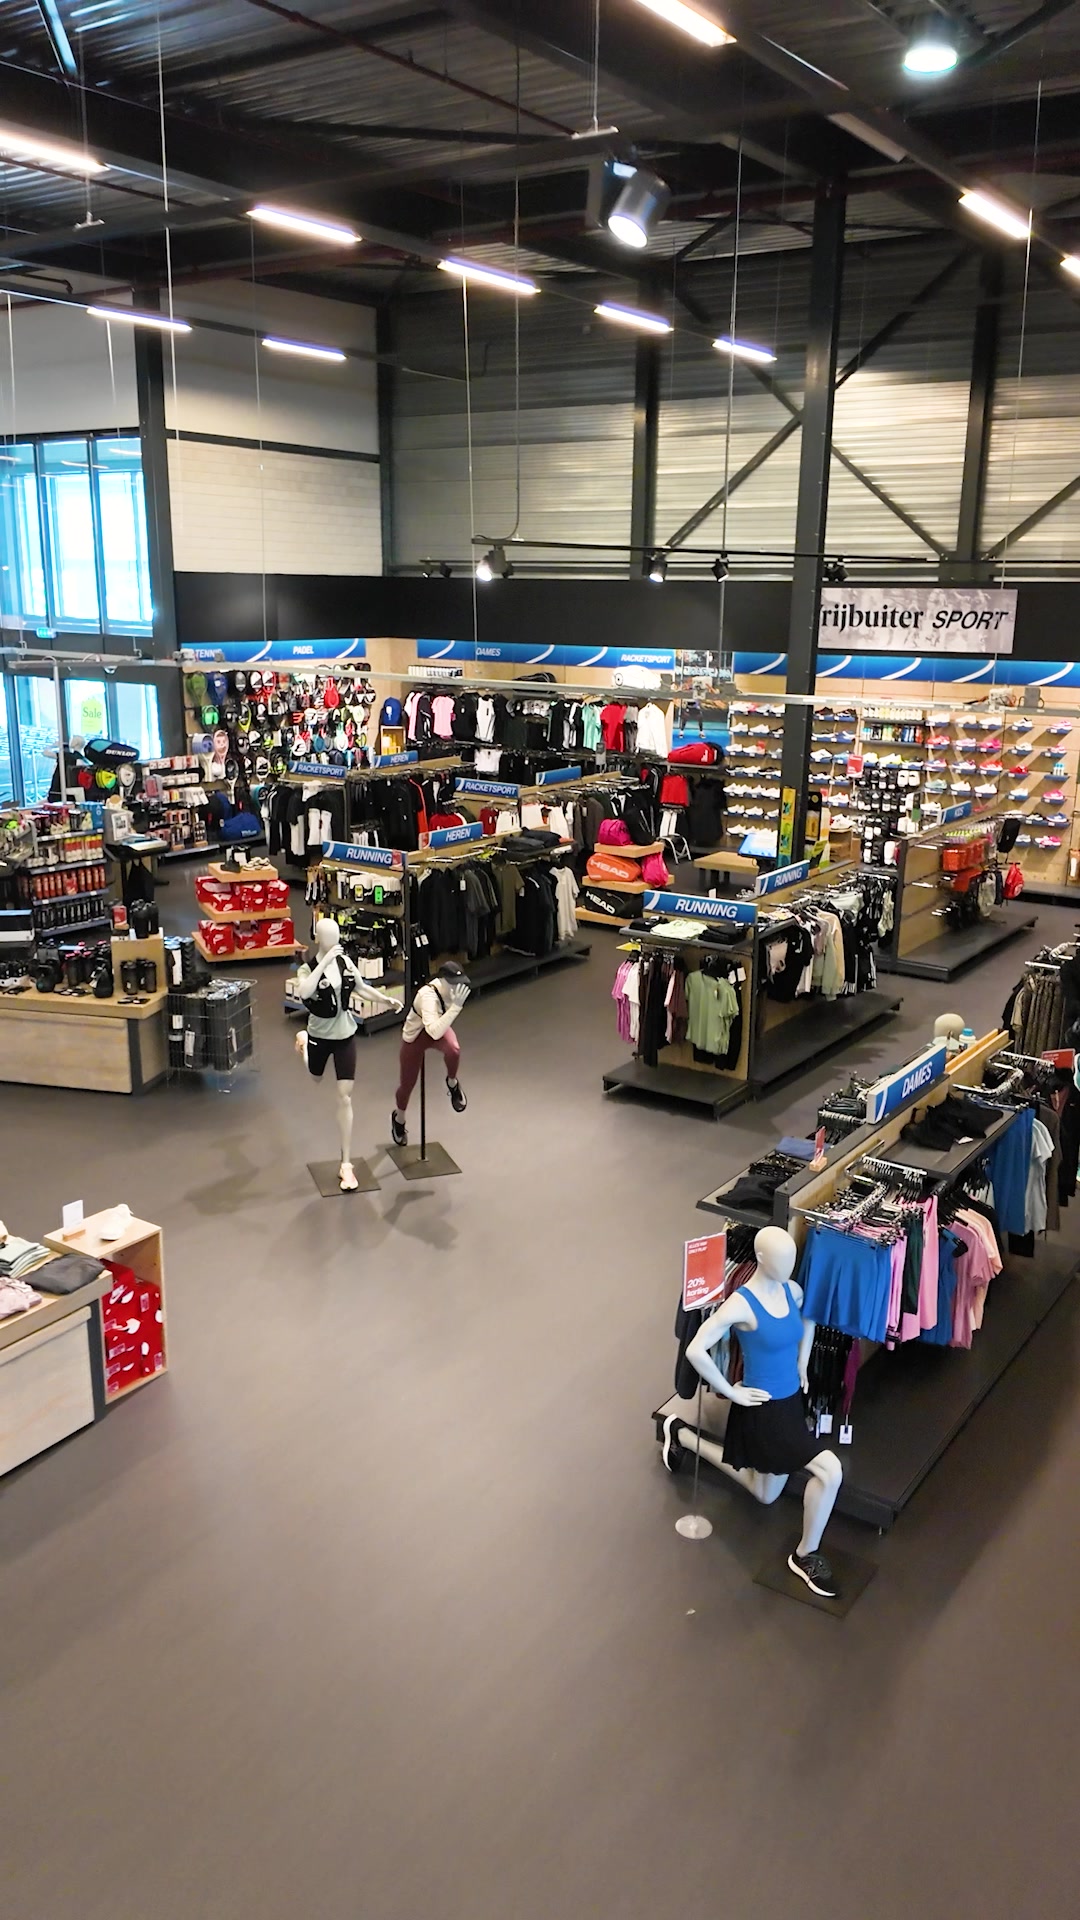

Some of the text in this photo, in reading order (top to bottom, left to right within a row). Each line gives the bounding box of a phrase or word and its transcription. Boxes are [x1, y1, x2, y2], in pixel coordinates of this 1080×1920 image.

[820, 603, 1009, 633] rijbuiter SPORT
[292, 645, 314, 655] PADEL
[475, 647, 501, 657] DAMES
[620, 654, 672, 664] RACKETSPORT
[82, 706, 102, 718] Sale
[105, 749, 137, 757] DUNLOP
[390, 754, 409, 764] HEREN
[297, 763, 343, 776] RACKETSPORT
[464, 782, 517, 796] RACKETSPORT
[445, 827, 472, 843] HEREN
[346, 847, 392, 865] RUNNING
[590, 859, 630, 879] HEAD
[774, 867, 803, 888] RUNNING
[585, 890, 615, 915] HEAD
[675, 898, 738, 919] RUNNING
[902, 1061, 932, 1098] DAMES
[688, 1277, 706, 1288] 20%
[687, 1287, 709, 1297] korting
